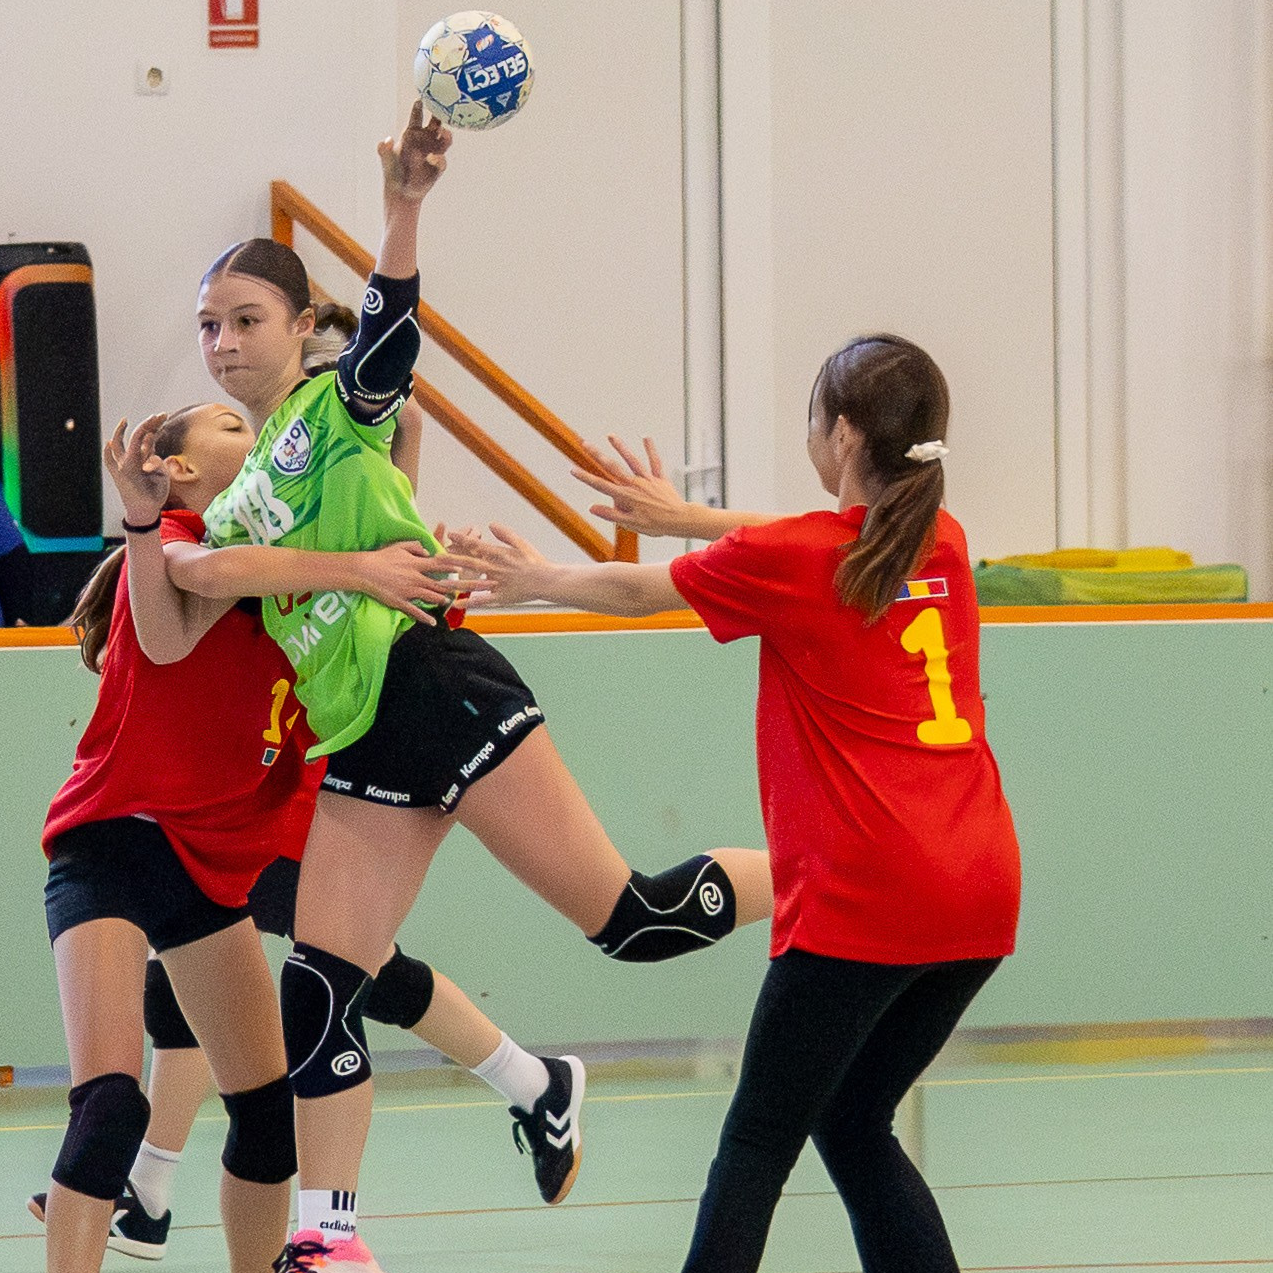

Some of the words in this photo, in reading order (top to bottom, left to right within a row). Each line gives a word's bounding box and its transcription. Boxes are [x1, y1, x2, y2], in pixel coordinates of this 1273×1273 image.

[464, 52, 526, 93] SELECT
[900, 606, 973, 745] 1
[459, 741, 495, 778] Kempa
[365, 784, 411, 803] Kempa
